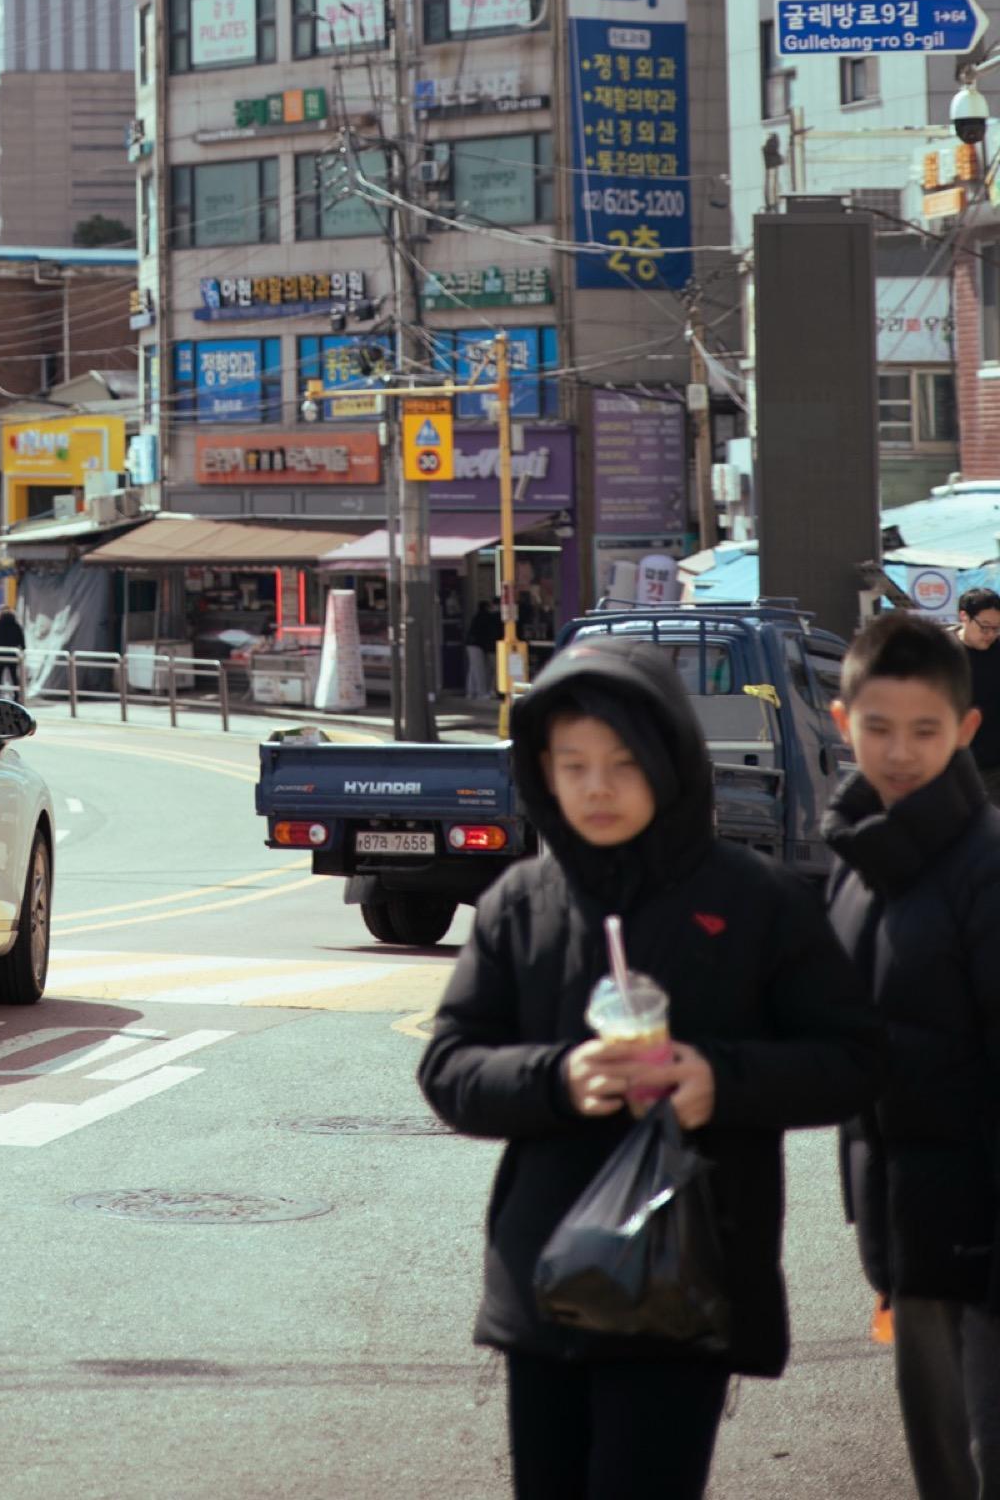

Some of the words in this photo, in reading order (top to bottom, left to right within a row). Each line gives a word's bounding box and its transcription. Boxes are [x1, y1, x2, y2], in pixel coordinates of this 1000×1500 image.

[784, 1, 919, 31] 굴레방로9길
[200, 21, 248, 41] PILATES
[784, 34, 900, 51] Gullebang-ro
[903, 31, 944, 49] 9-gil
[593, 53, 677, 82] 정형외과
[593, 86, 678, 115] 재활의학과
[595, 118, 679, 147] 신경외과
[607, 224, 664, 281] 2층
[200, 349, 256, 385] 정형외과
[418, 454, 440, 471] 30
[344, 780, 421, 795] HYUNDAI
[395, 834, 427, 851] 7658
